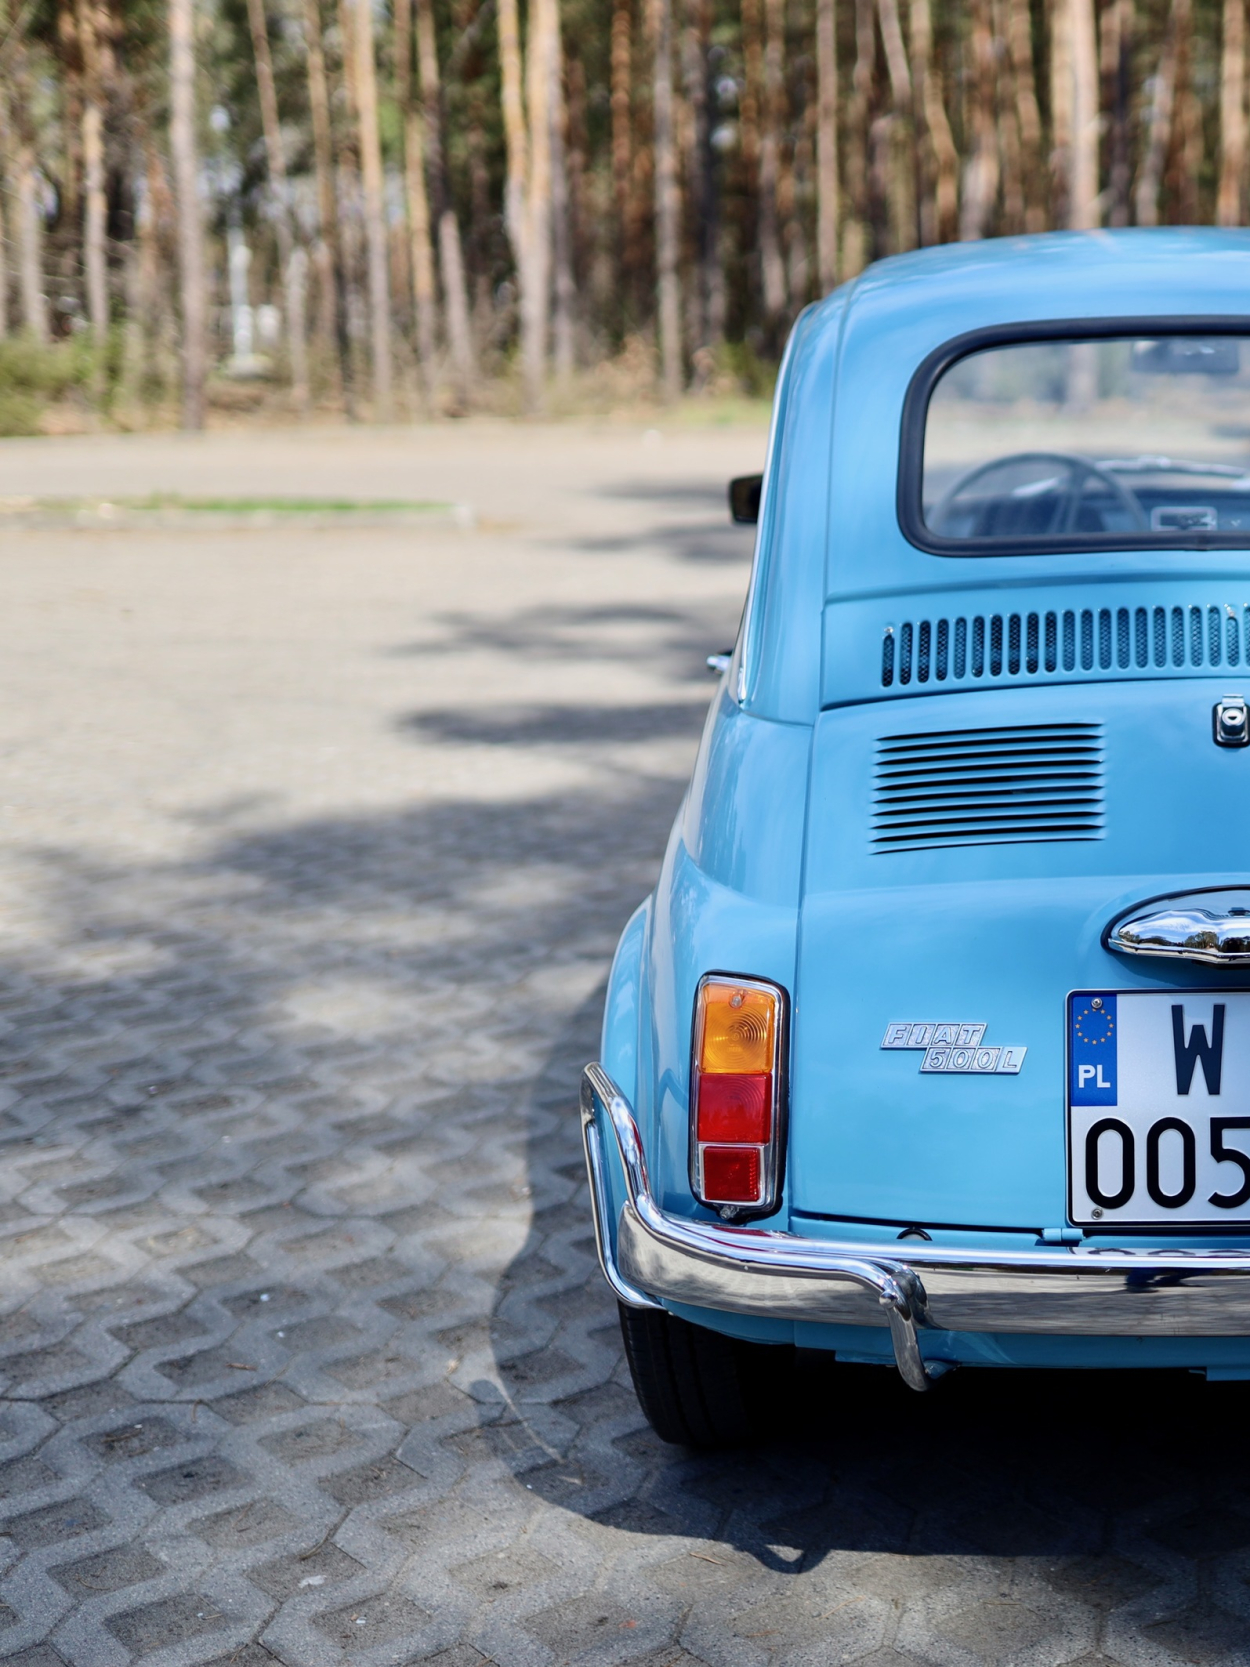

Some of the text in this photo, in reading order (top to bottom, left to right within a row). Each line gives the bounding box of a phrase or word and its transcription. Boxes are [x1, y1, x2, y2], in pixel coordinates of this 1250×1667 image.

[889, 1026, 980, 1045] FIAT
[929, 1050, 1018, 1069] 500L
[1078, 1064, 1111, 1088] PL
